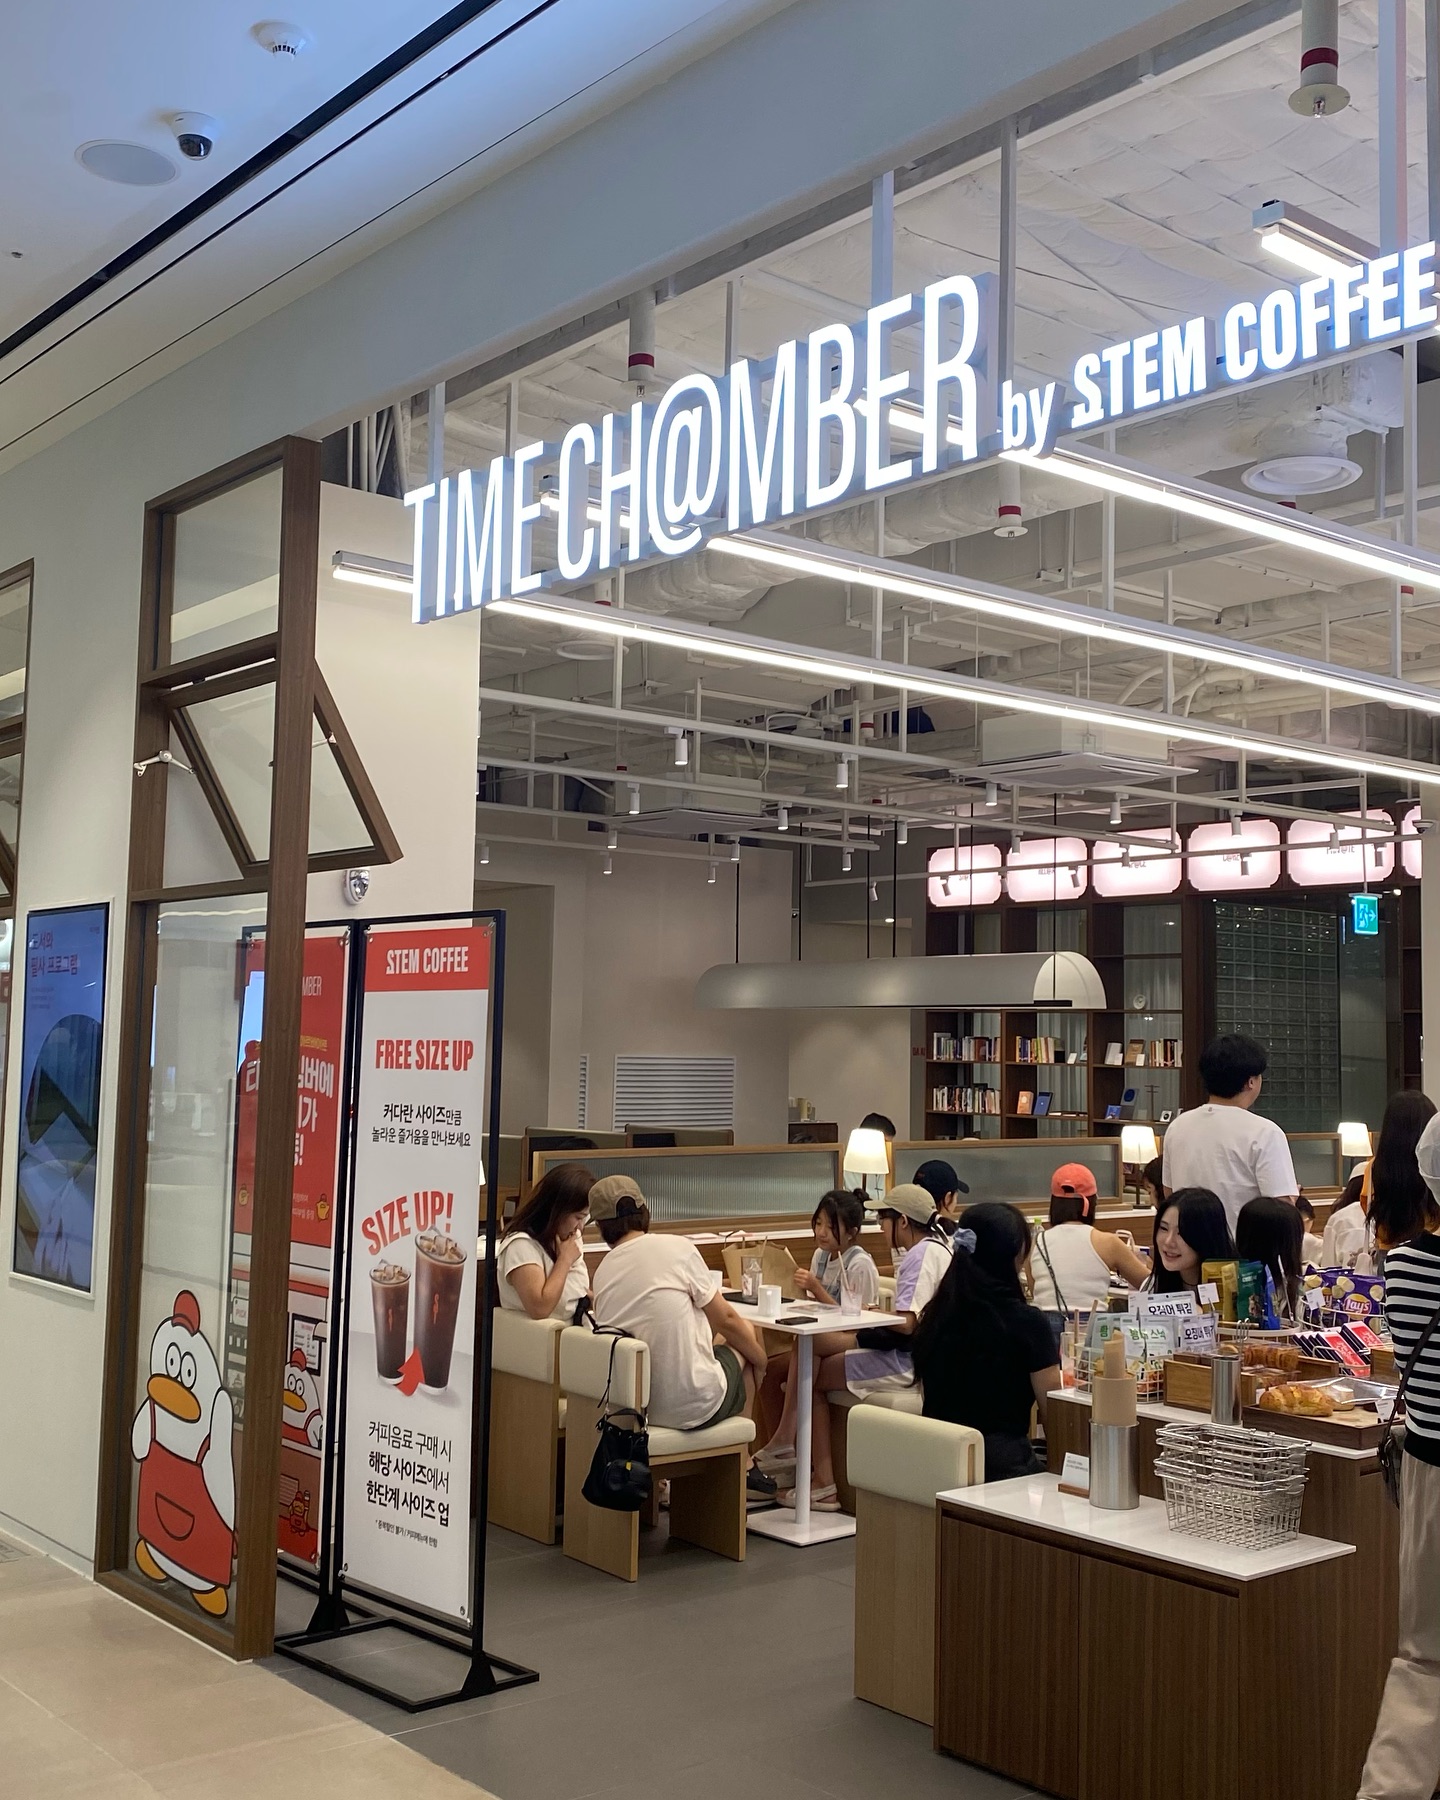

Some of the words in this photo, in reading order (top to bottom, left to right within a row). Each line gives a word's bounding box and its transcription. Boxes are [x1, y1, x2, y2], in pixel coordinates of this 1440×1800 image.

[1001, 379, 1056, 458] by
[1071, 316, 1207, 429] STEM
[1224, 240, 1438, 381] COFFEE
[31, 956, 45, 977] 필사
[47, 955, 78, 975] 프로그램
[386, 949, 420, 975] STEM
[423, 946, 469, 973] COFFEE
[375, 1039, 412, 1070] FREE
[415, 1039, 449, 1071] SIZE
[452, 1040, 474, 1072] UP
[383, 1103, 413, 1124] 커다란
[415, 1104, 462, 1126] 사이즈만큼
[372, 1126, 396, 1143] 놀라운
[398, 1128, 429, 1145] 즐거움을
[431, 1130, 471, 1147] 만나보세요
[361, 1195, 411, 1256] SIZE
[413, 1190, 454, 1233] UP!
[368, 1420, 413, 1450] 커피음료
[415, 1432, 439, 1460] 구매
[440, 1440, 452, 1463] 시
[368, 1451, 392, 1477] 해당
[393, 1457, 449, 1494] 사이즈에서
[366, 1480, 400, 1511] 한단계
[401, 1491, 436, 1520] 사이즈
[438, 1502, 449, 1527] 업
